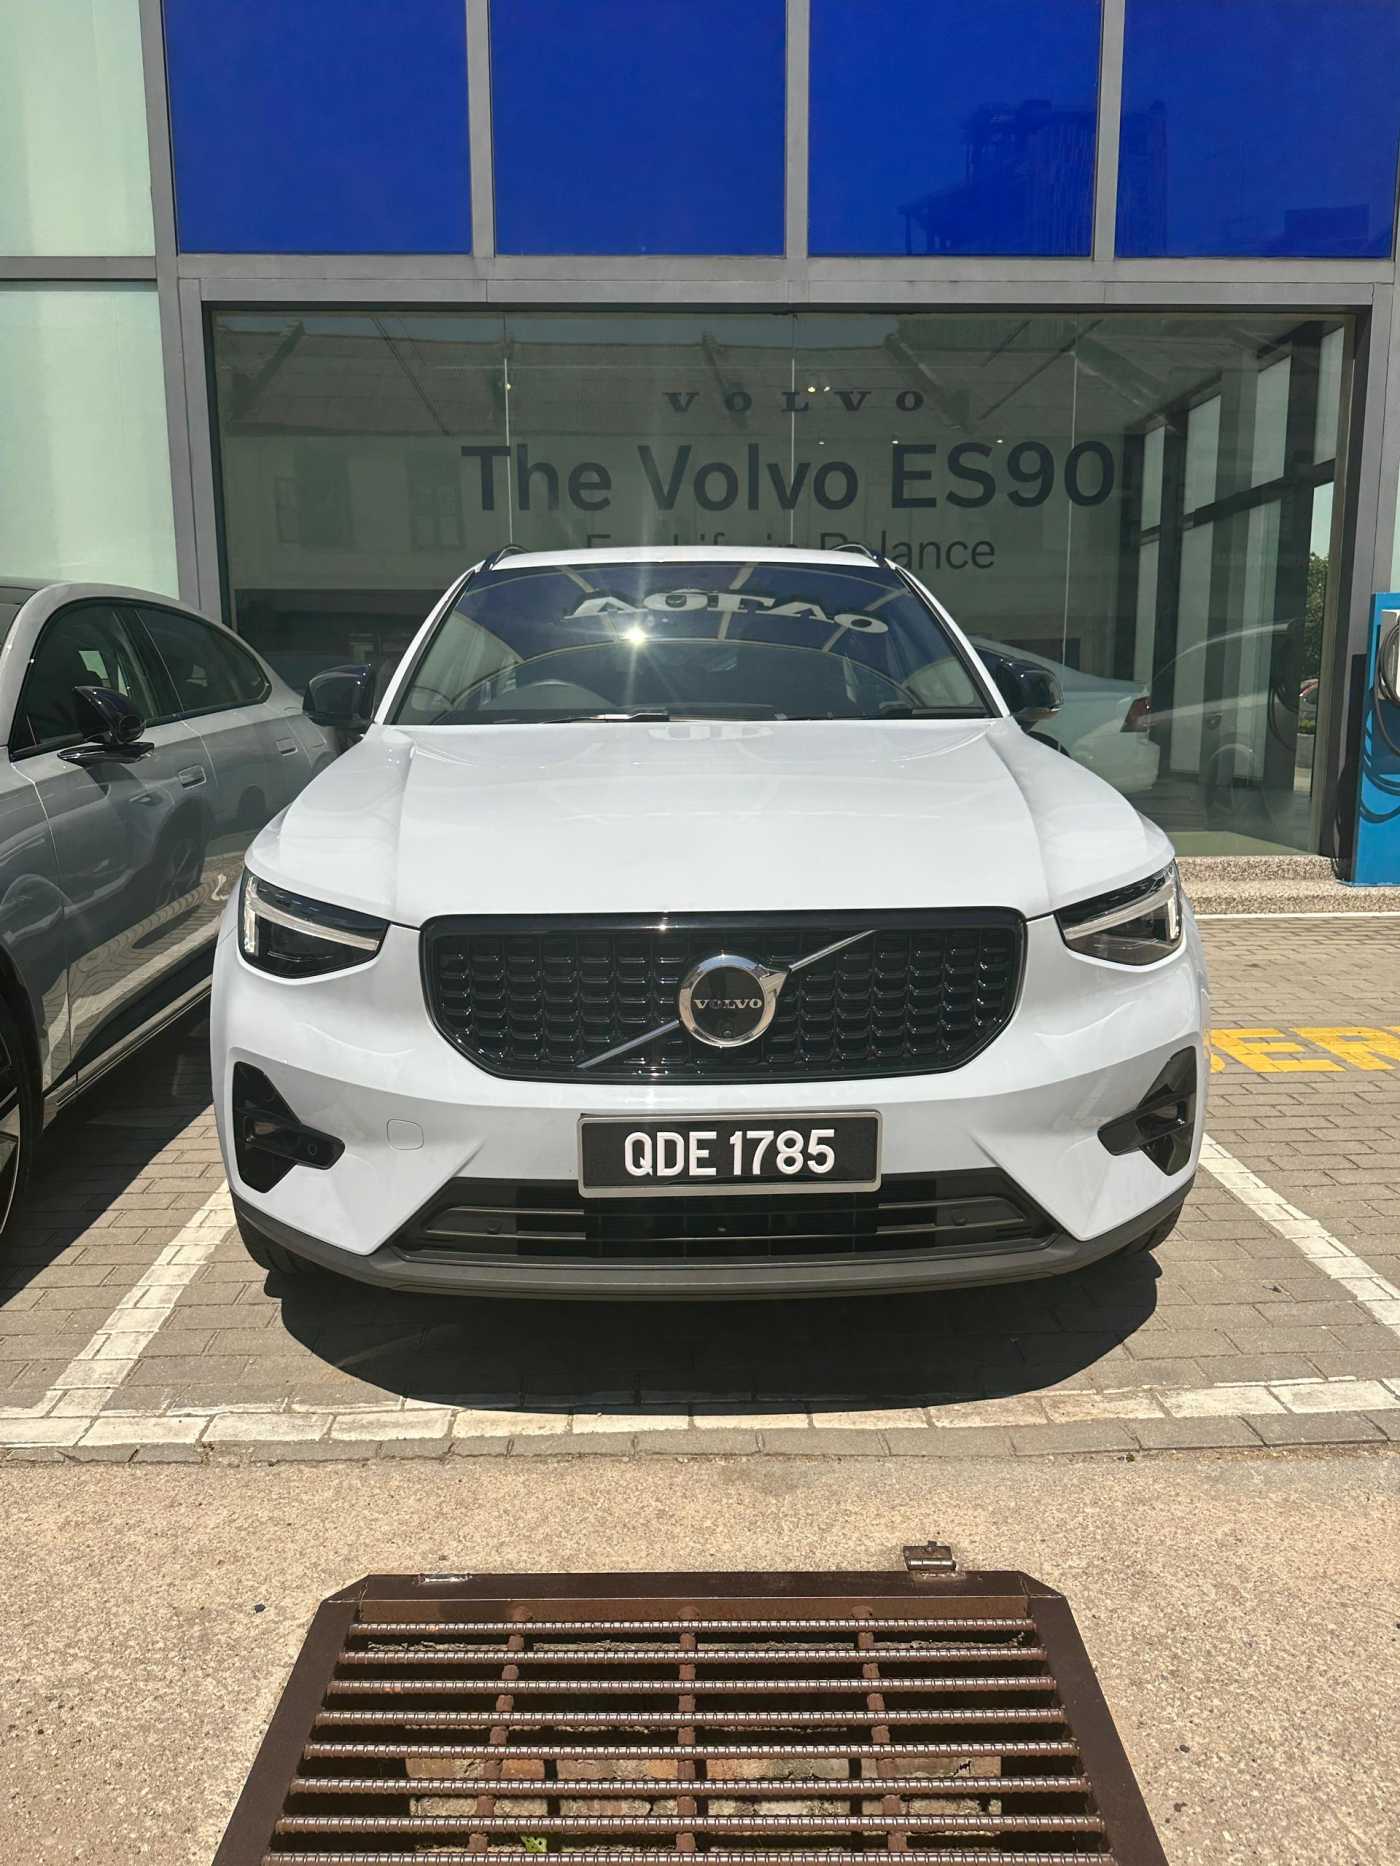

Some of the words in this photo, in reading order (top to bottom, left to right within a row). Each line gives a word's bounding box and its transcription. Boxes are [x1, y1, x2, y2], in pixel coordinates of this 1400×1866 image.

[662, 391, 925, 413] VOLVO
[461, 443, 612, 511] The
[637, 443, 858, 511] Volvo
[892, 440, 1115, 509] ES90
[694, 999, 762, 1009] VOLVO
[624, 1131, 717, 1177] QDE
[729, 1129, 836, 1176] 1785
